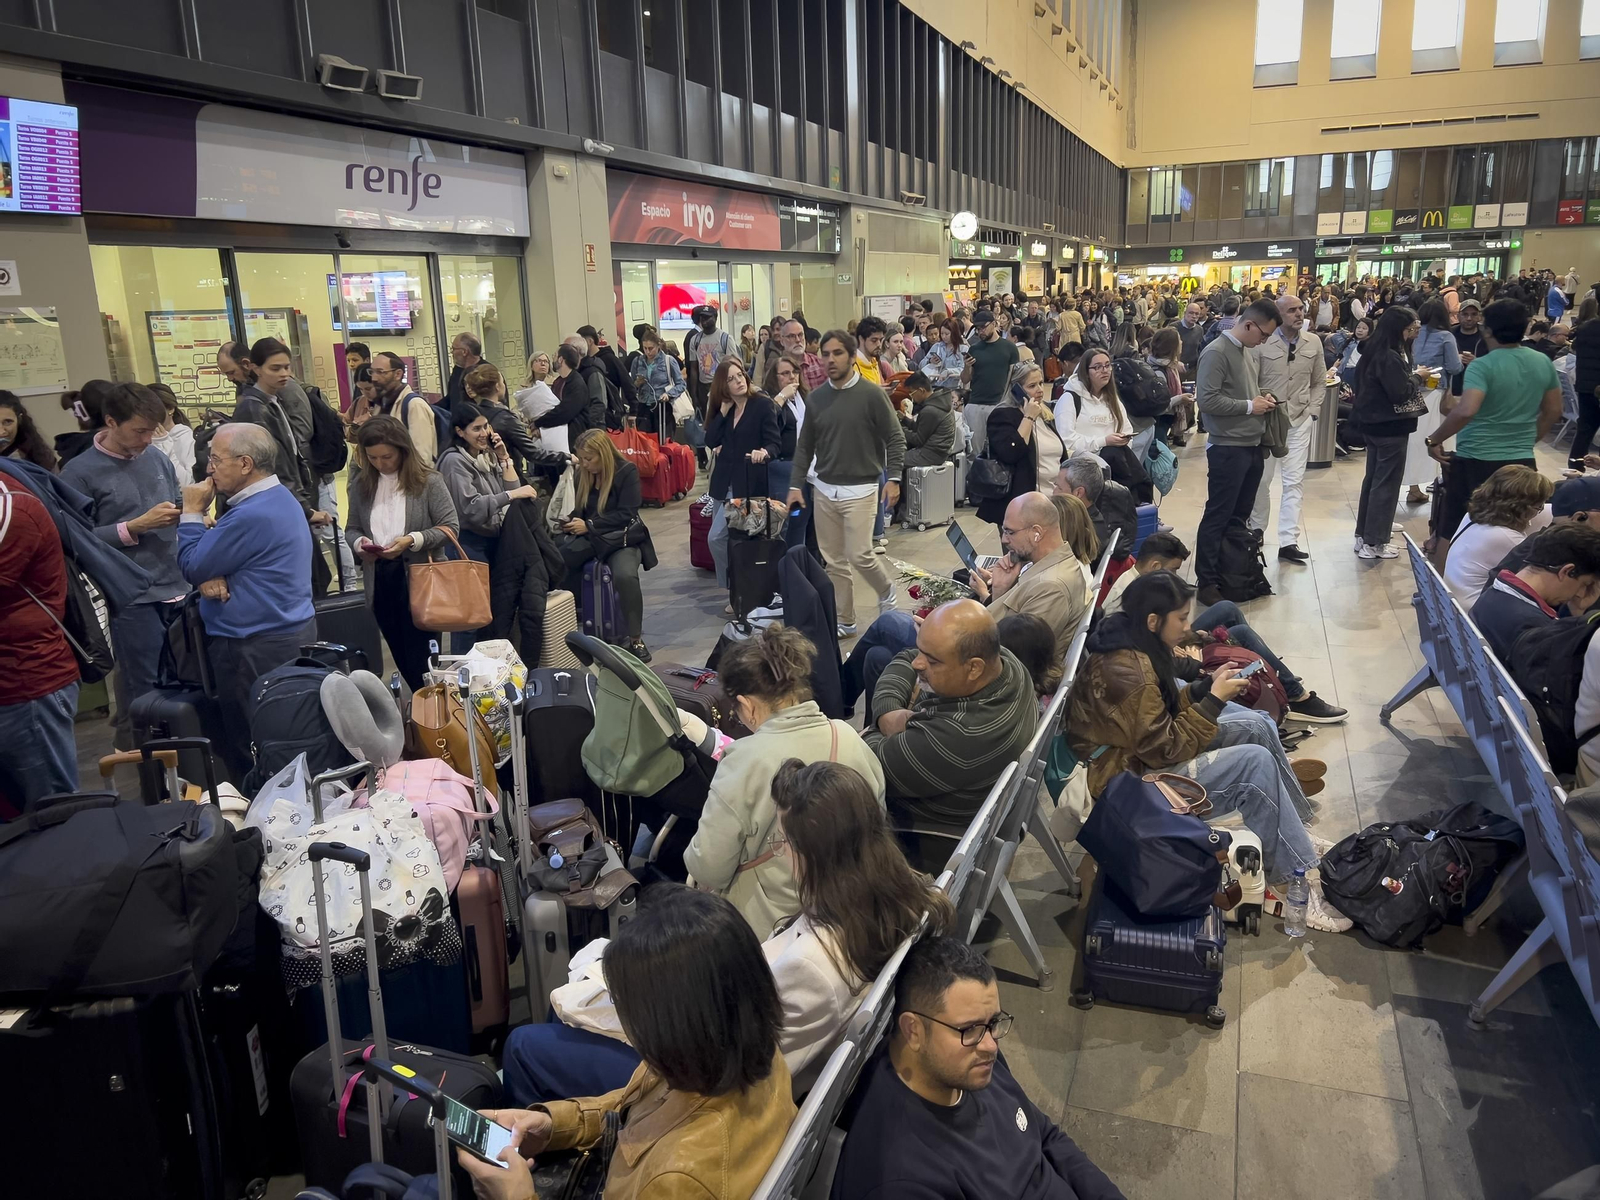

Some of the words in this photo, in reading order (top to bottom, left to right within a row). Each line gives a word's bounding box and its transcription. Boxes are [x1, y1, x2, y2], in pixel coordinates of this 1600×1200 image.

[346, 155, 442, 211] renfe
[642, 202, 670, 220] Espacio
[682, 192, 714, 238] iryo
